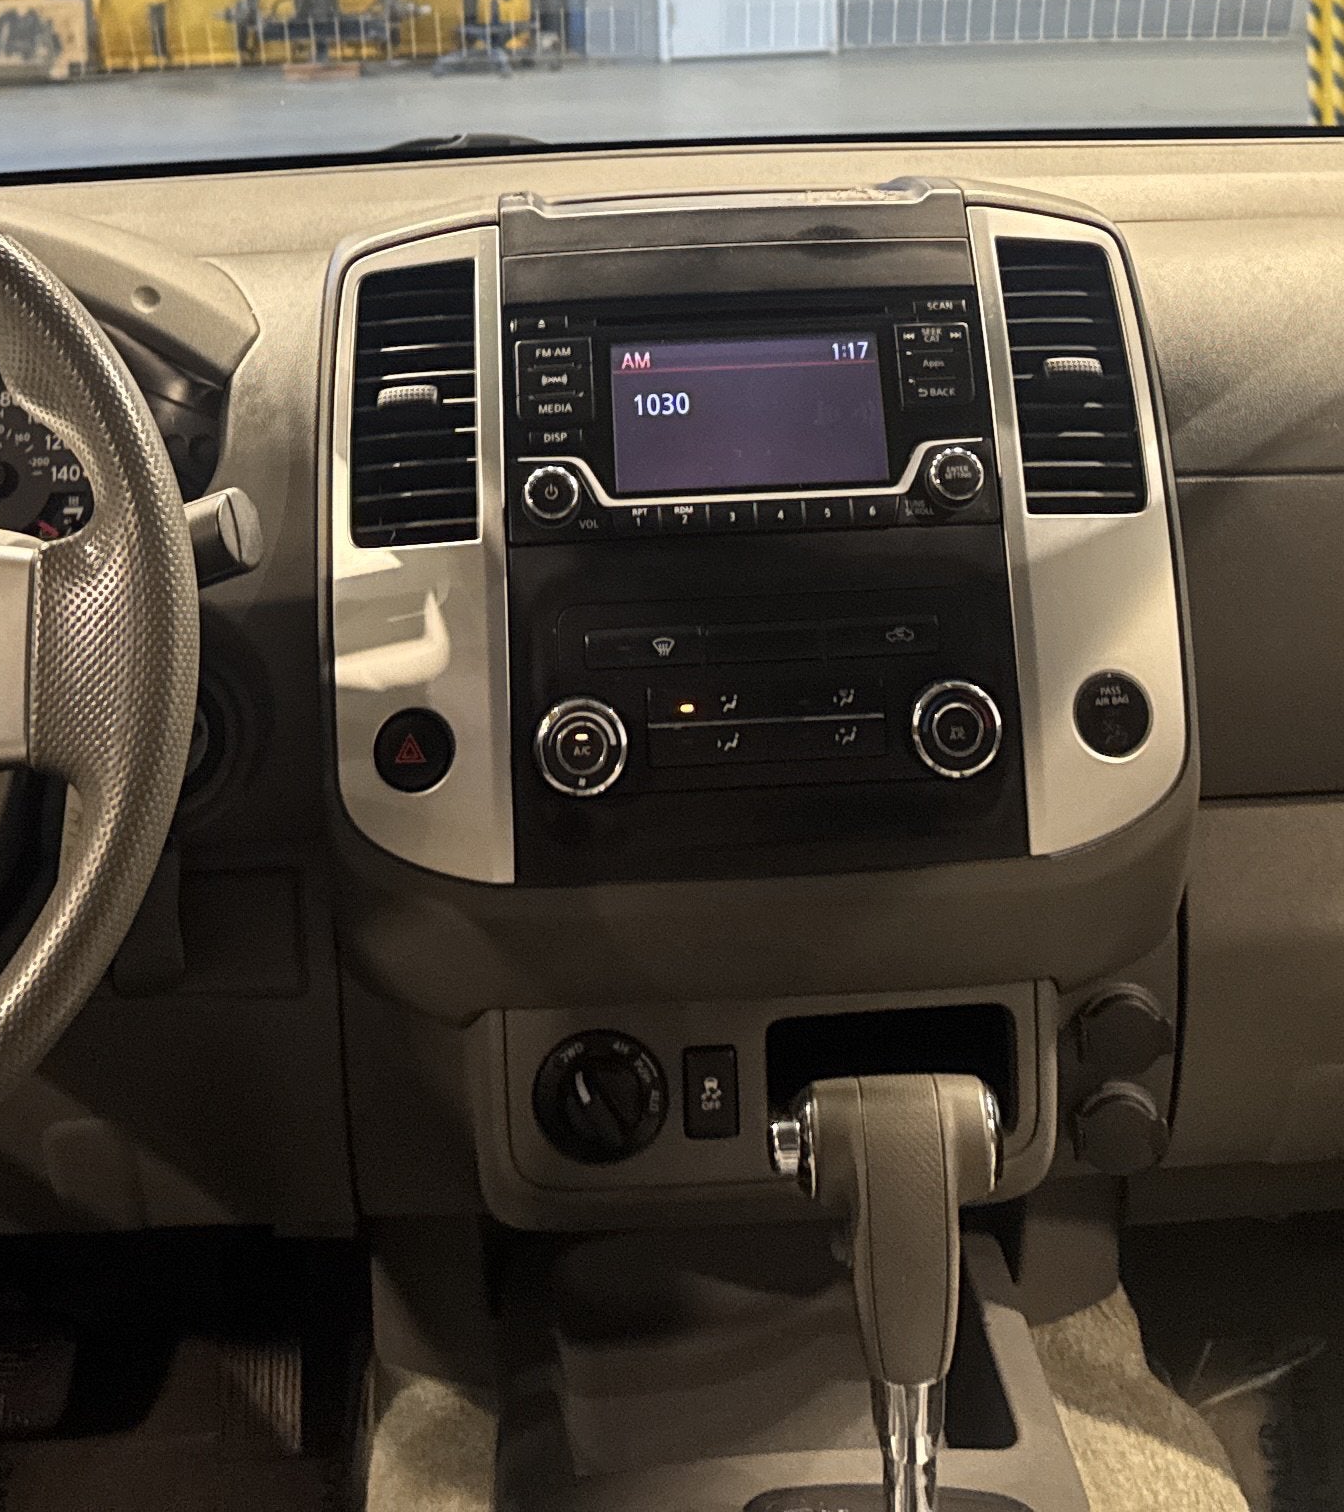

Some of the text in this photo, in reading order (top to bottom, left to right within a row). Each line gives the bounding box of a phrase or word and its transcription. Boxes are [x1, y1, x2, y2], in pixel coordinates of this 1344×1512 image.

[926, 301, 954, 311] SCAN
[831, 341, 869, 362] 1:17
[620, 351, 652, 370] AM
[929, 388, 956, 397] BACK
[537, 402, 573, 415] MEDIA
[633, 392, 691, 416] 1030
[543, 431, 568, 444] DISP
[50, 465, 81, 483] 140
[631, 507, 648, 517] RPT
[729, 511, 736, 522] 3
[776, 509, 785, 521] 4
[824, 507, 831, 519] 5
[578, 519, 599, 530] VOL
[681, 514, 688, 525] 2
[1099, 685, 1122, 696] PASS
[1094, 695, 1130, 707] AIR BAG
[573, 745, 592, 757] A/C
[559, 1041, 585, 1063] 2WD
[700, 1100, 722, 1111] OFF
